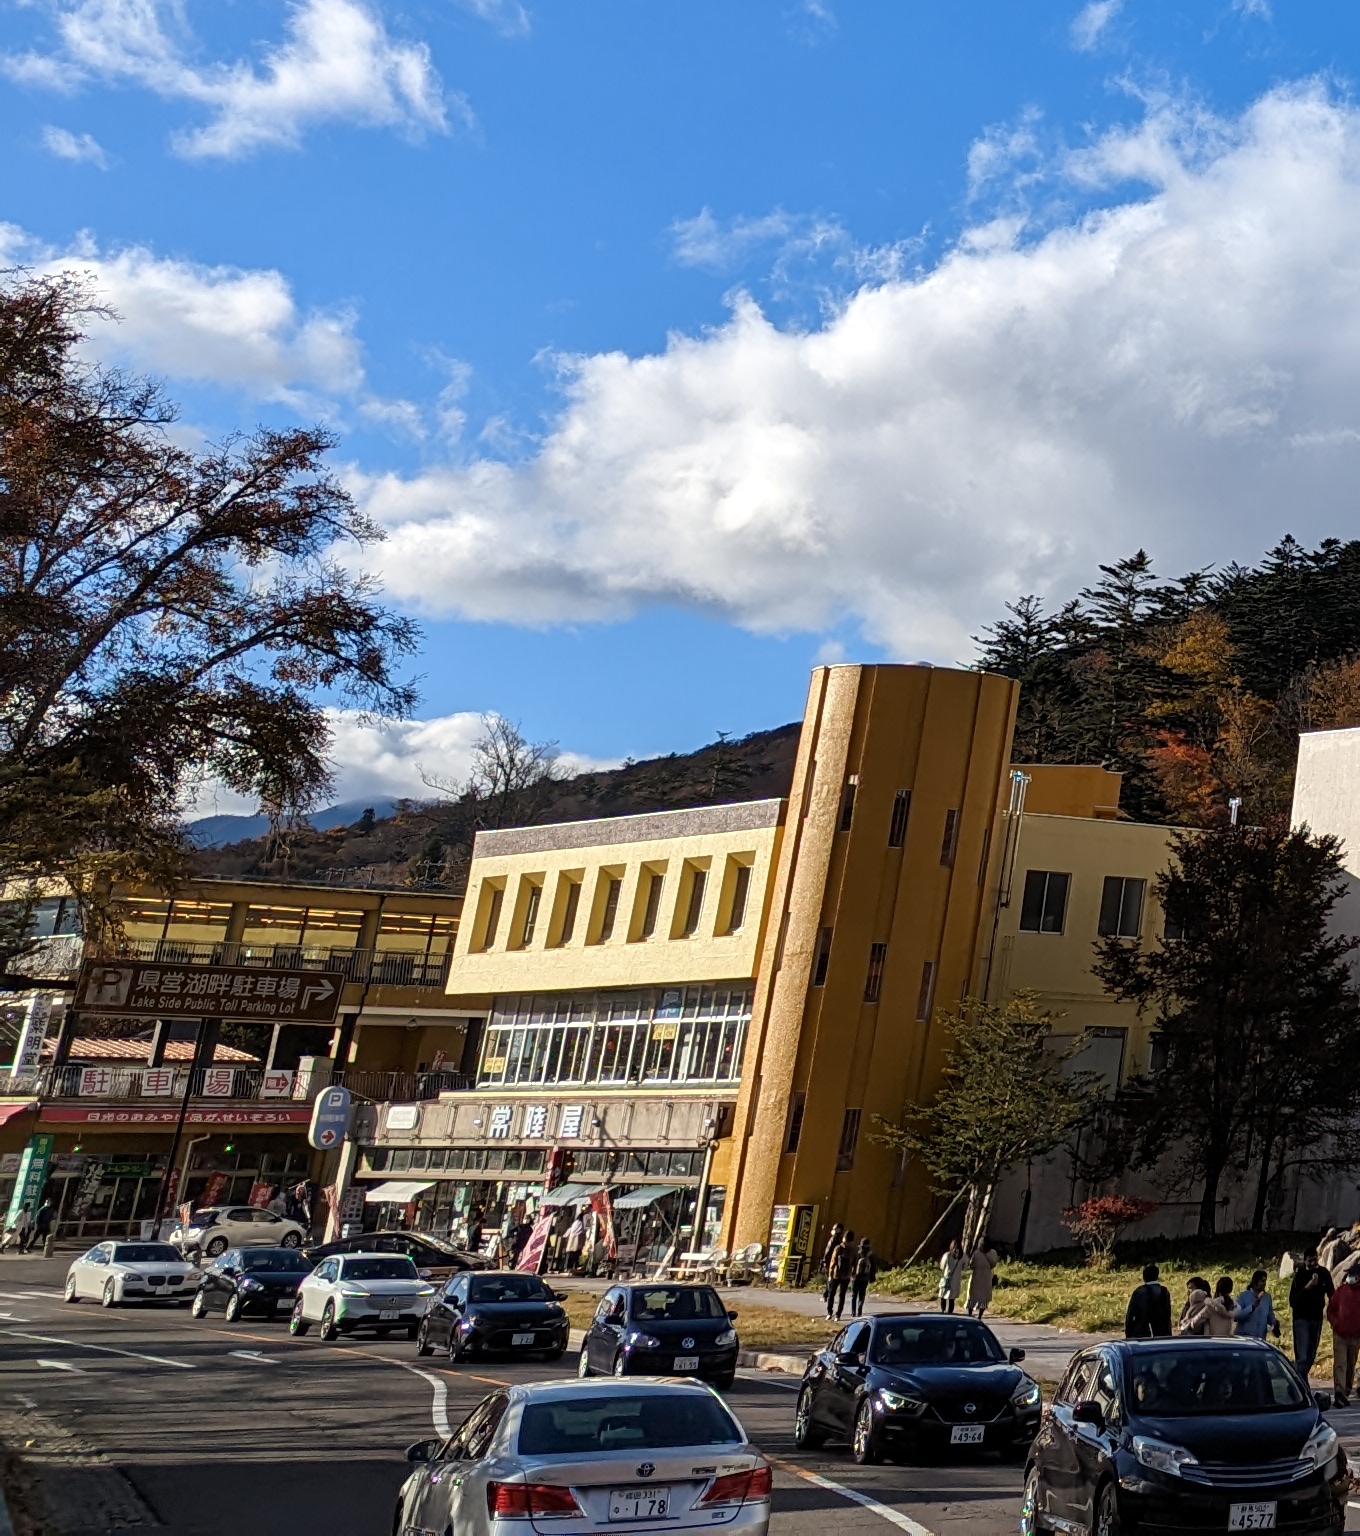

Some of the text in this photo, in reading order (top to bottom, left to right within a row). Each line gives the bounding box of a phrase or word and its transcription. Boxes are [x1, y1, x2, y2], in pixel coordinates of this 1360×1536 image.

[135, 970, 300, 999] 県営湖畔駐車場
[131, 995, 155, 1009] Lake
[158, 995, 182, 1010] Side
[184, 997, 216, 1012] Public
[240, 1000, 277, 1015] Parking
[280, 1002, 295, 1014] Lot
[81, 1069, 232, 1095] 駐車場
[330, 1095, 341, 1105] P
[489, 1105, 583, 1138] 常陸屋
[1238, 1513, 1274, 1529] 45-77
